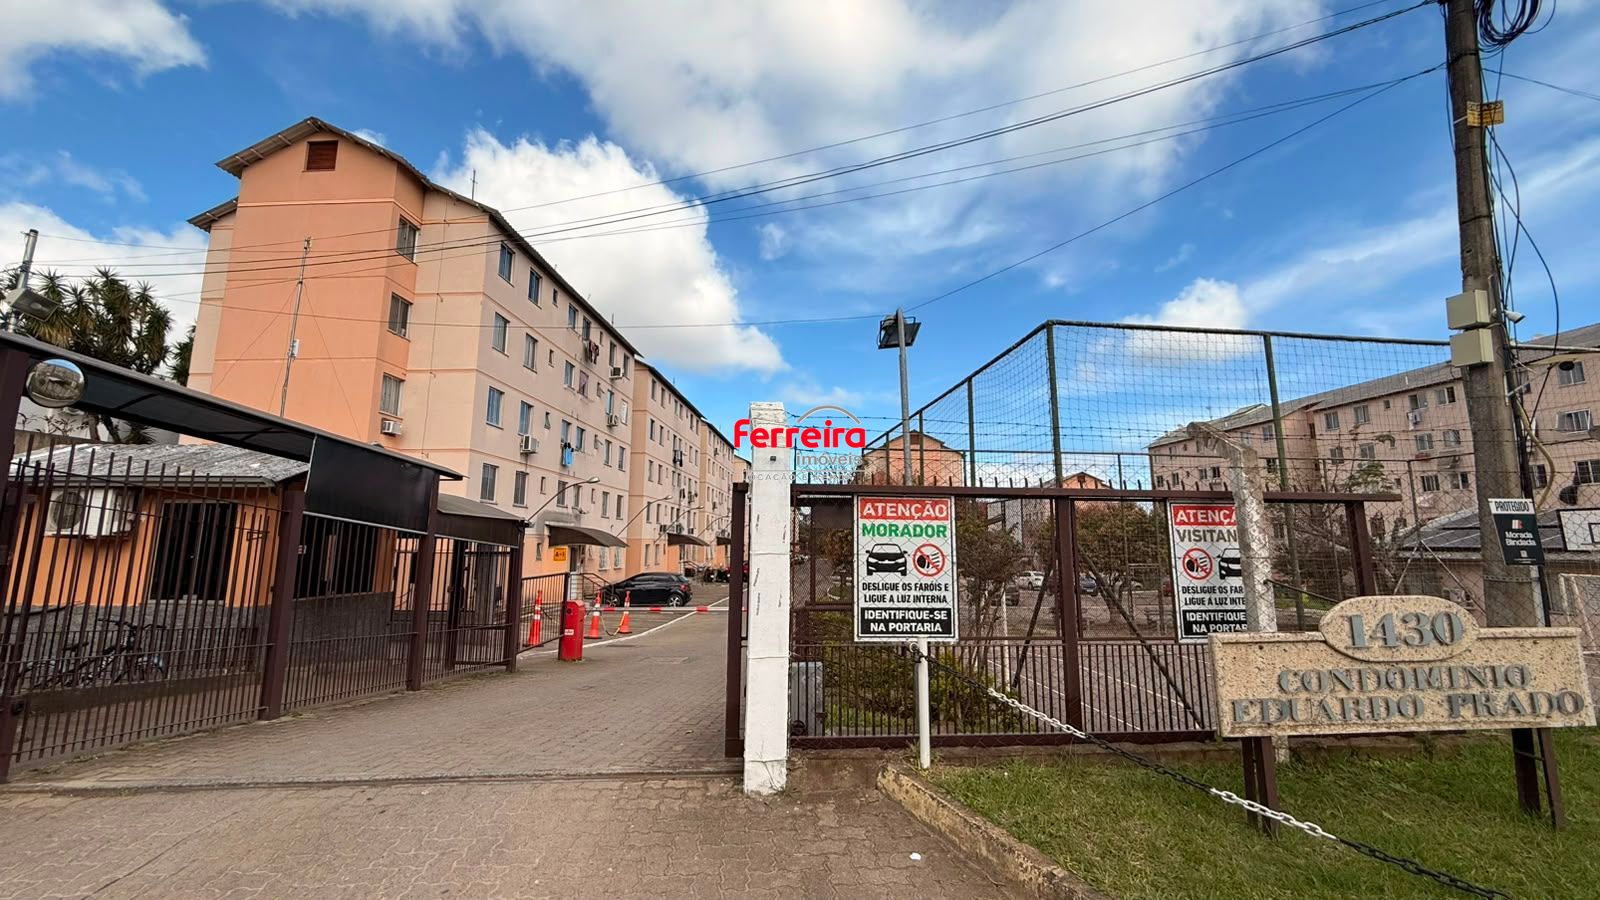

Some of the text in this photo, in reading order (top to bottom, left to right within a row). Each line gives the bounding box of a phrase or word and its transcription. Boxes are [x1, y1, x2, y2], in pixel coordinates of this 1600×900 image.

[863, 501, 947, 519] ATENÇÃO
[1494, 501, 1530, 512] PROTEGIDO
[862, 523, 947, 538] MORADOR
[1175, 528, 1238, 543] VISITAN
[1505, 531, 1533, 539] Morada
[862, 580, 949, 592] DESLIGUE OS FARÓIS E
[1181, 585, 1217, 594] DESLIGUE
[1218, 585, 1228, 594] OS
[864, 594, 947, 603] LIGUE A LUZ INTERNA
[1184, 597, 1206, 606] LIGUE
[1208, 597, 1214, 606] A
[1215, 597, 1228, 606] LUZ
[864, 610, 948, 620] IDENTIFIQUE-SE
[1186, 612, 1247, 621] IDENTIFIQUE
[870, 622, 942, 632] NA PORTARIA
[1192, 623, 1208, 633] NA
[1344, 611, 1464, 648] 1430
[1278, 663, 1532, 694] CONDOMINIO
[1231, 689, 1586, 724] EDUARDO PRADO
